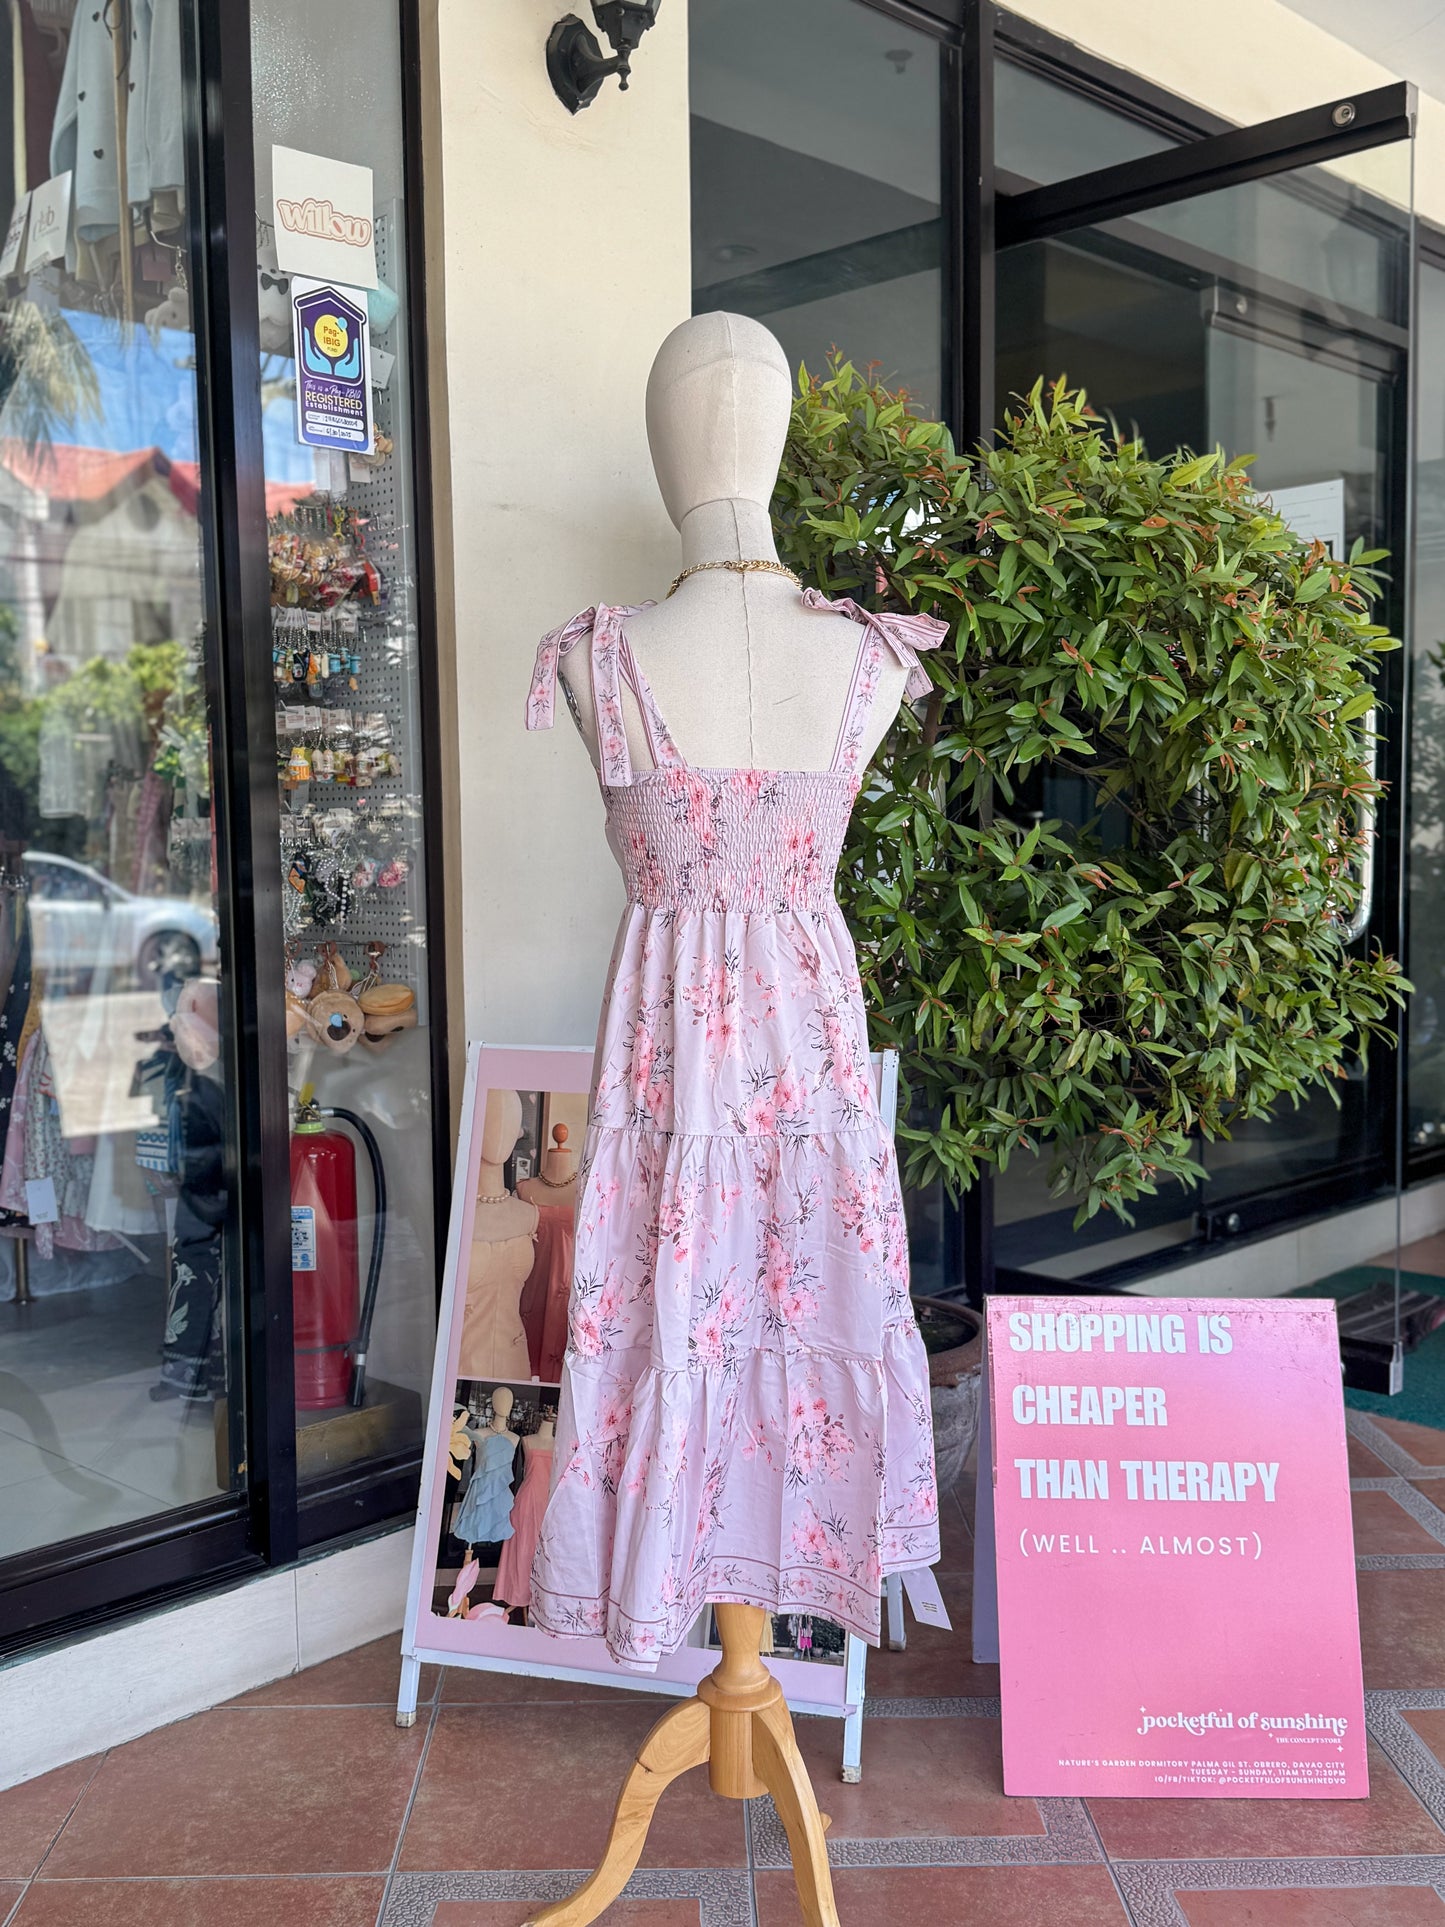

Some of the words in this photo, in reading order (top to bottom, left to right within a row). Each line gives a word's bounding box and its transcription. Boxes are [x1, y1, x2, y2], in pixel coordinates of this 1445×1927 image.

[323, 336, 340, 347] IBIG
[305, 391, 363, 410] REGISTERED
[305, 400, 363, 417] Establishment
[1008, 1312, 1187, 1354] SHOPPING
[1198, 1314, 1234, 1355] IS
[1012, 1384, 1168, 1427] CHEAPER
[1014, 1458, 1110, 1500] THAN
[1120, 1460, 1280, 1503] THERAPY
[1019, 1528, 1101, 1557] (WELL
[1140, 1531, 1263, 1561] ALMOST)
[1136, 1711, 1235, 1736] pocketful
[1237, 1711, 1259, 1729] of
[1260, 1713, 1349, 1737] sunshine
[1058, 1759, 1100, 1767] NATURE'S
[1138, 1760, 1189, 1768] DORMITORY
[1238, 1761, 1251, 1769] ST.
[1253, 1761, 1291, 1770] OBRERO,
[1190, 1768, 1229, 1776] TUESDAY
[1238, 1769, 1276, 1777] SUNDAY,
[1278, 1769, 1299, 1777] 11AM
[1301, 1769, 1313, 1777] TO
[1218, 1776, 1347, 1785] @POCKETFULOFSUNSHINEDVO
